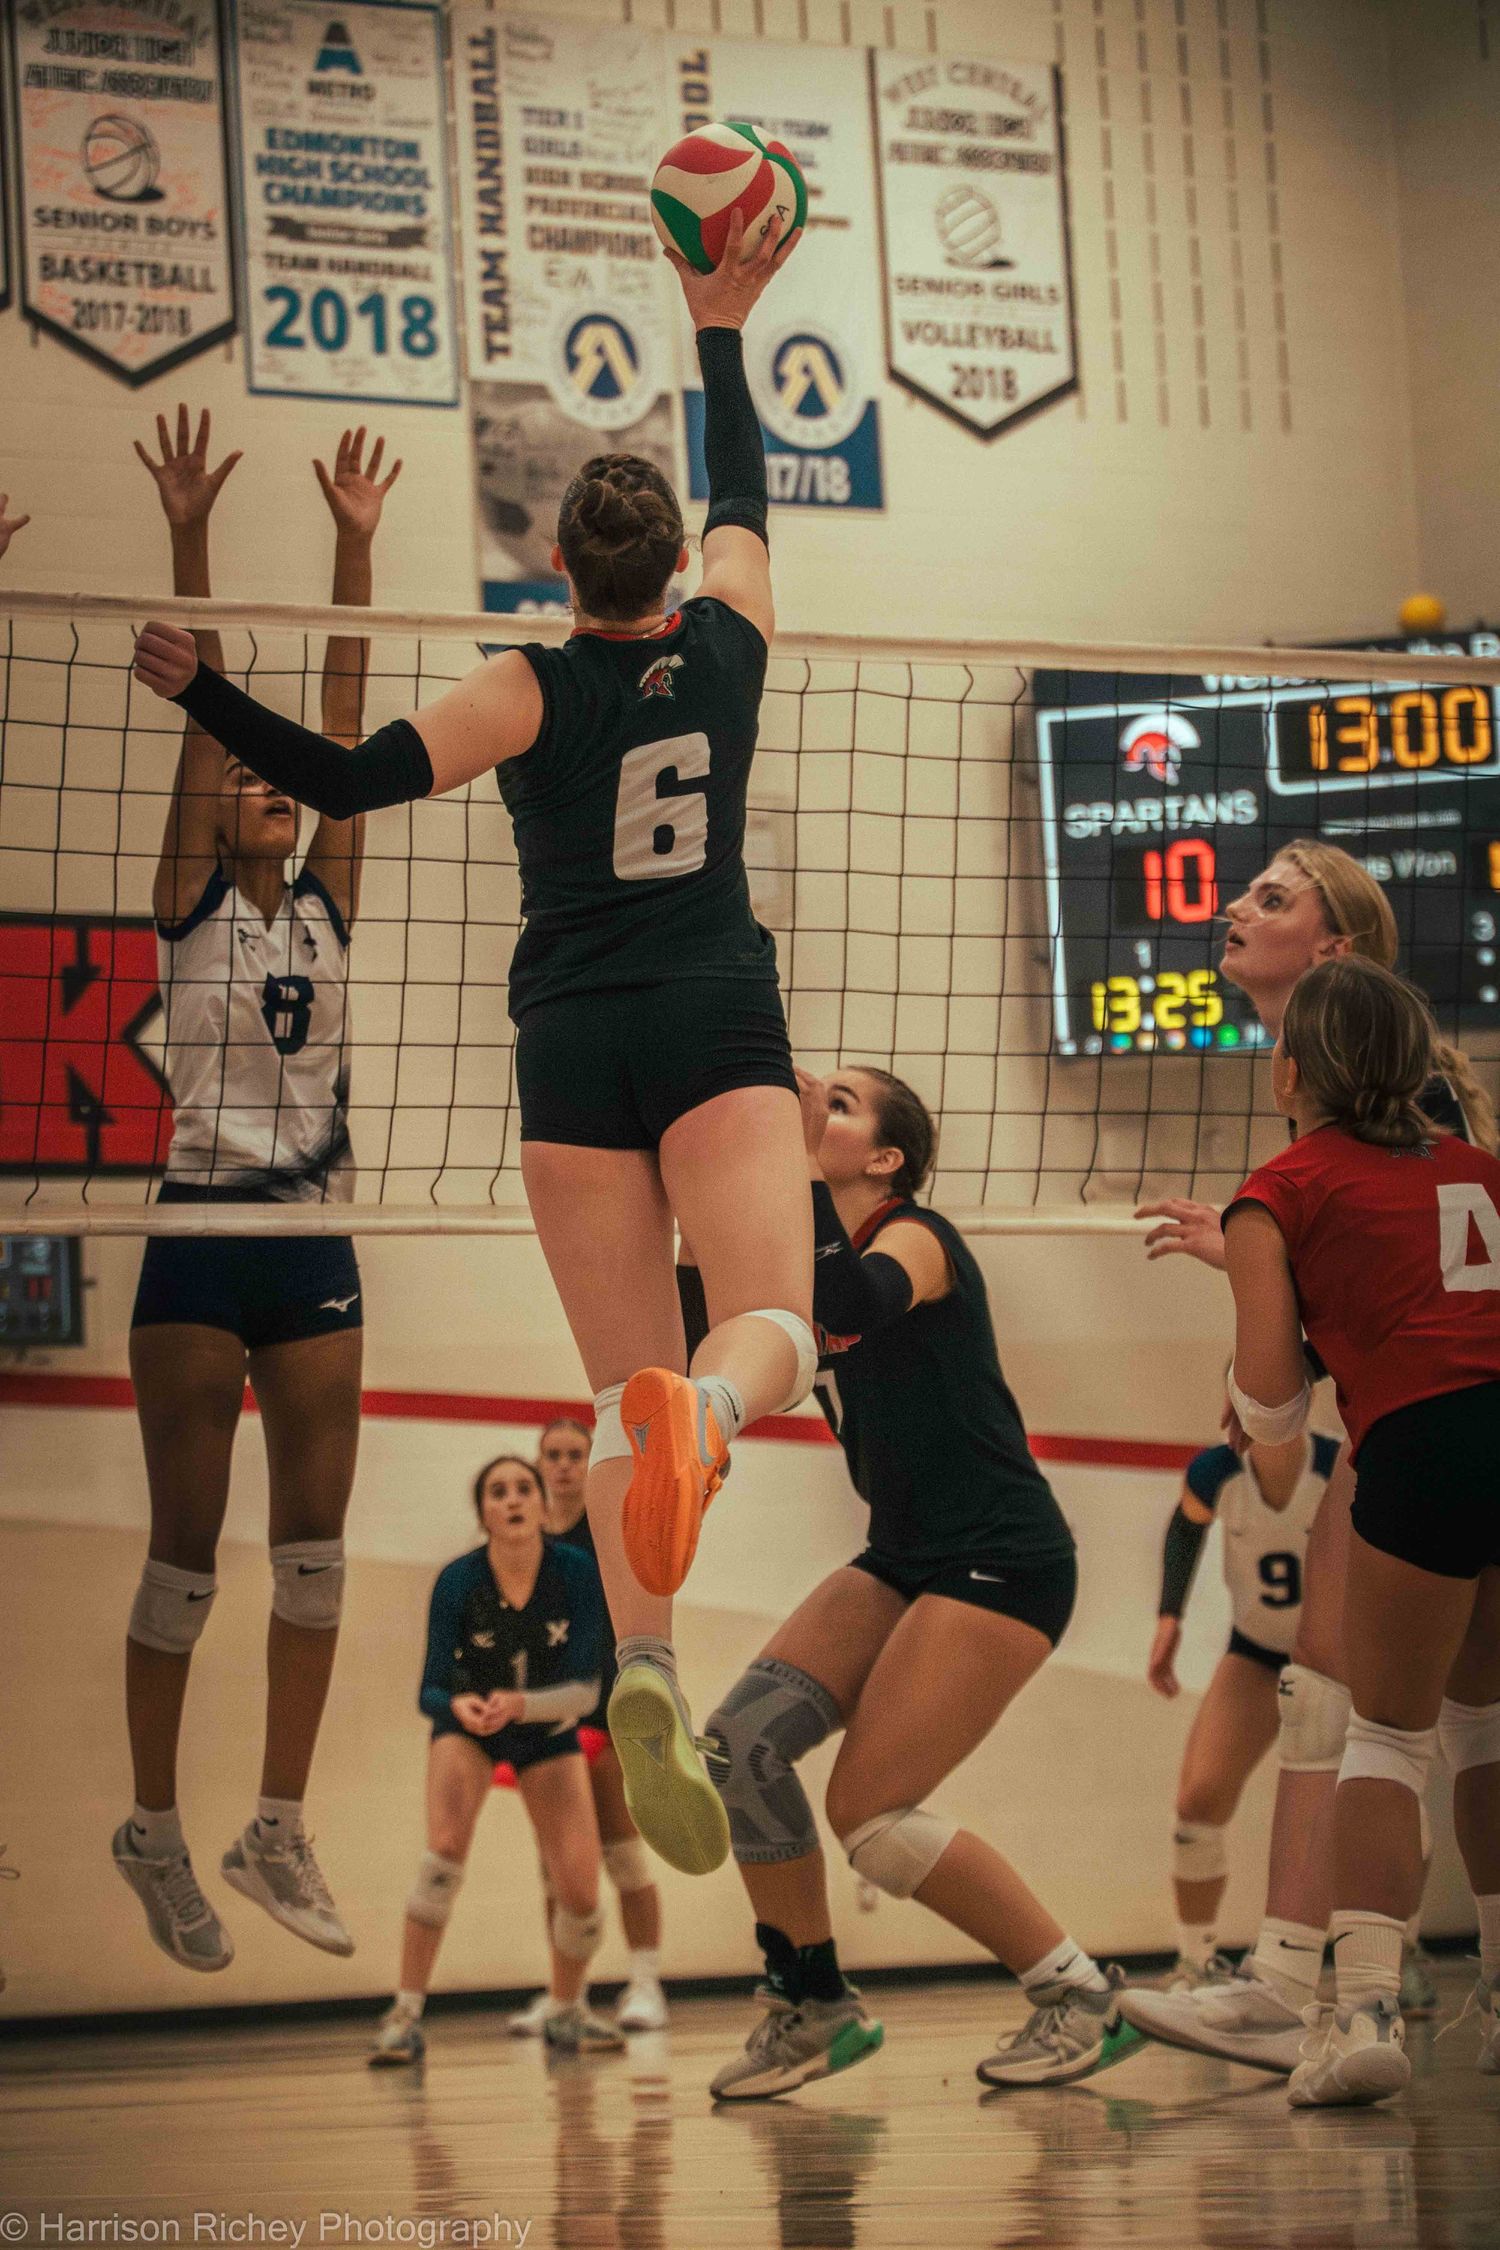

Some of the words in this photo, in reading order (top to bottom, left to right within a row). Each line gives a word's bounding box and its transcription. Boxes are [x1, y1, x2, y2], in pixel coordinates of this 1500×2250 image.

[265, 126, 420, 161] EDMONTON
[468, 26, 505, 236] HANDBALL
[256, 154, 322, 178] HIGH
[329, 161, 431, 190] SCHOOL
[263, 182, 427, 218] CHAMPIONS
[34, 207, 138, 232] SENIOR
[145, 217, 216, 241] BOYS
[528, 224, 657, 262] CHAMPIONS
[39, 254, 216, 294] BASKETBALL
[896, 277, 985, 299] SENIOR
[71, 298, 192, 337] 2017-2018
[264, 286, 437, 358] 2018
[479, 249, 513, 362] TEAM
[902, 319, 1058, 354] VOLLEYBALL
[1308, 687, 1493, 773] 13:00
[612, 731, 712, 881] 6
[1062, 788, 1260, 840] SPARTANS
[1143, 838, 1219, 924] 10
[1471, 910, 1496, 942] 3
[262, 973, 315, 1056] 8
[1090, 968, 1224, 1033] 13:25
[1259, 1552, 1302, 1610] 9
